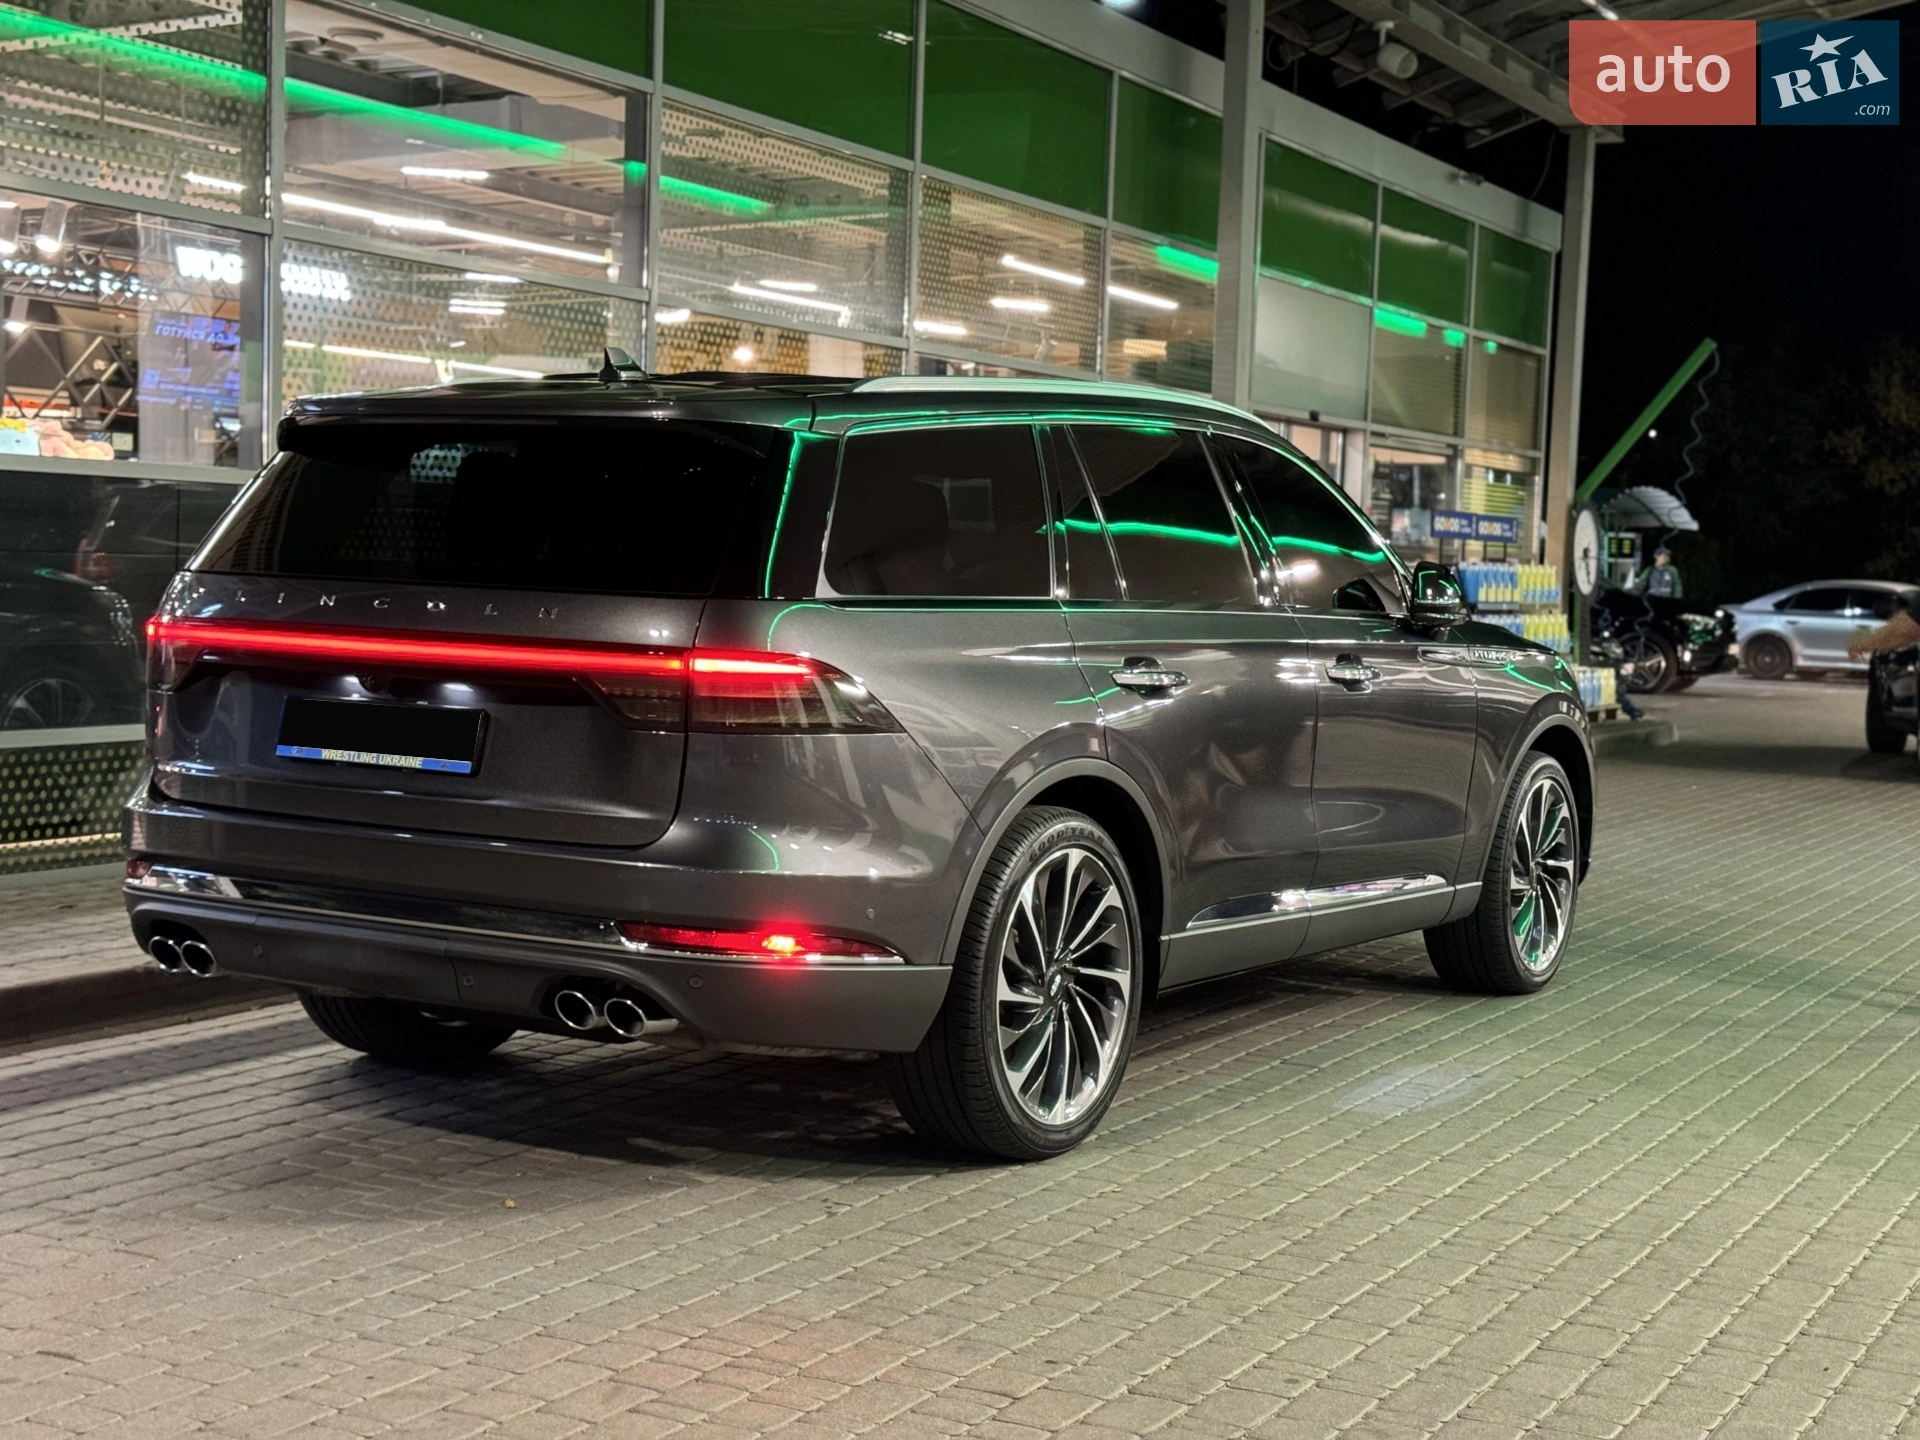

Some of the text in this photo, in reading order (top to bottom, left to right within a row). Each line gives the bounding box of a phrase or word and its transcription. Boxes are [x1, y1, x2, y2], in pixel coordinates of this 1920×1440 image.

[176, 246, 243, 284] WOG
[235, 589, 558, 620] LINCOLN
[322, 748, 424, 769] WRESTLING UKRAINE
